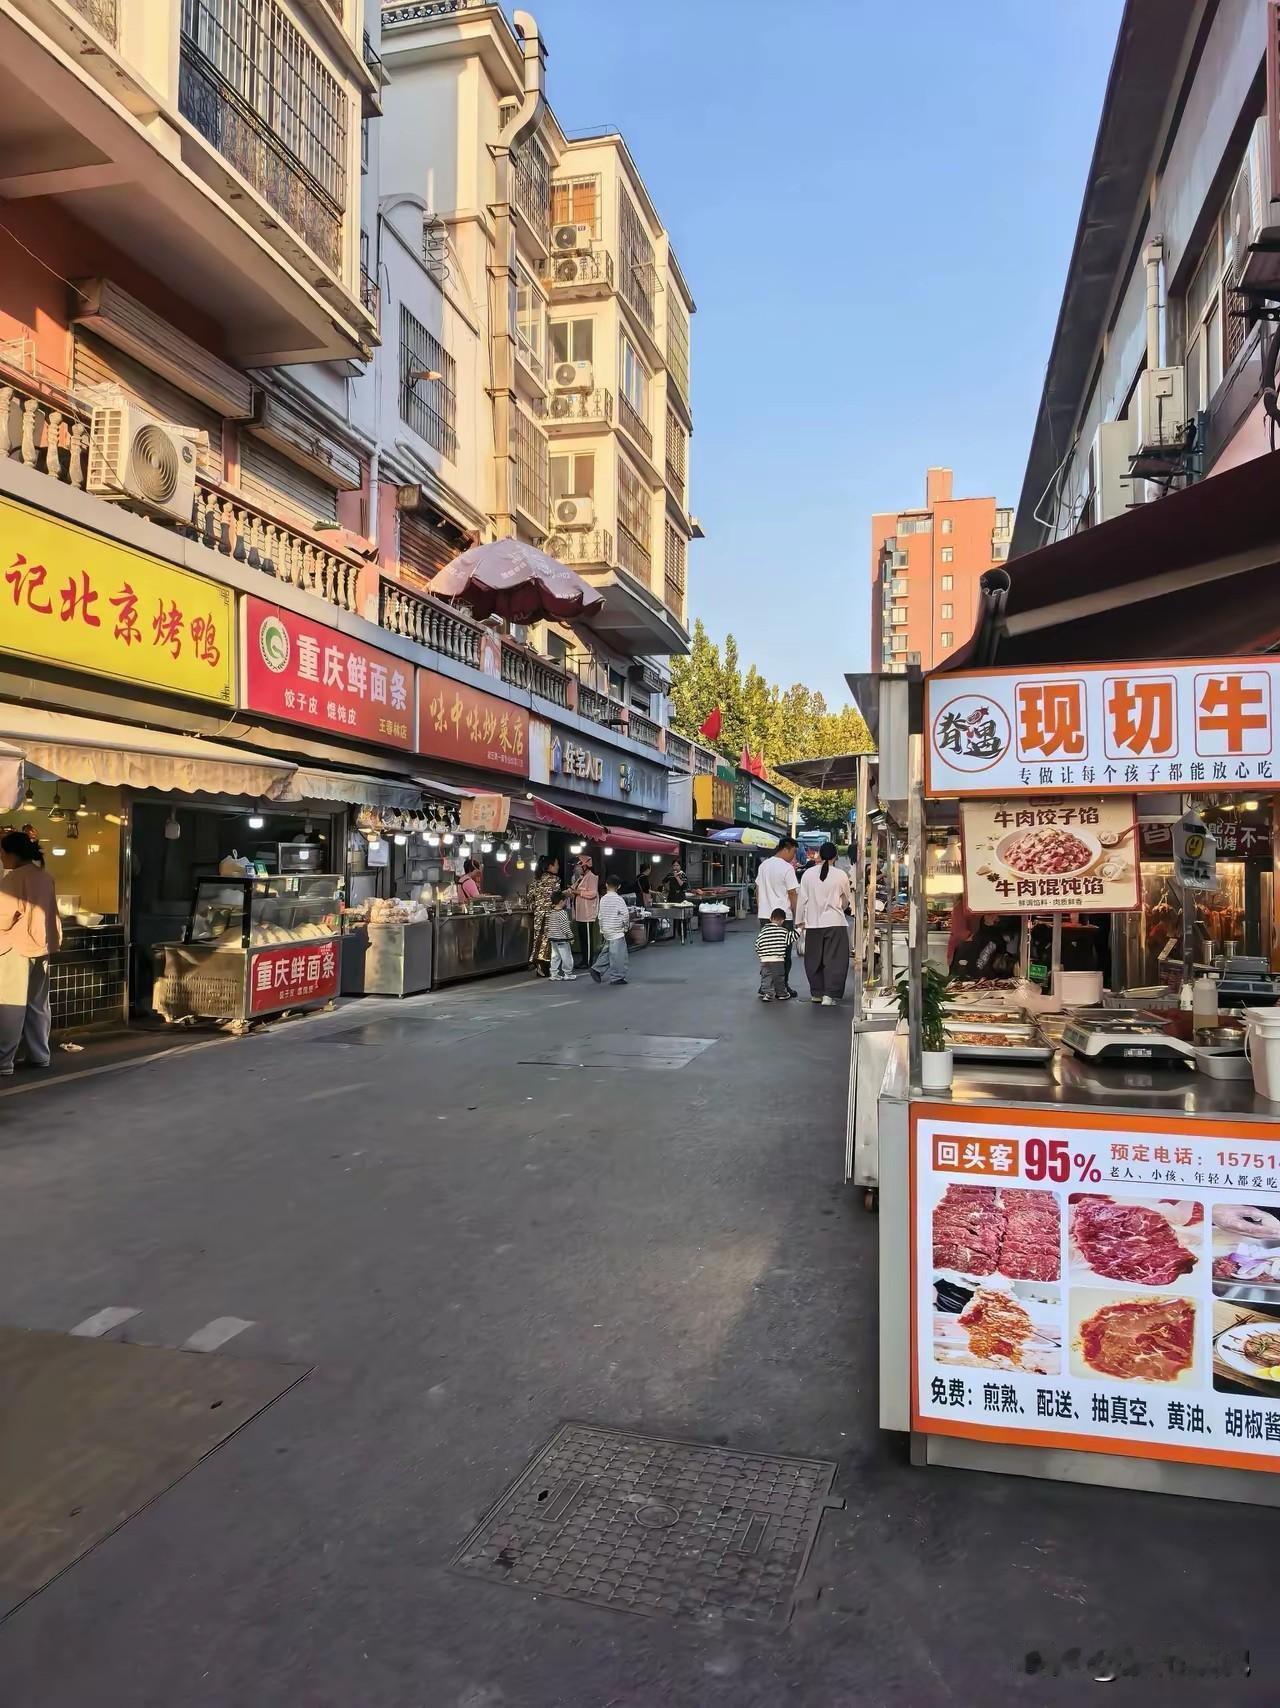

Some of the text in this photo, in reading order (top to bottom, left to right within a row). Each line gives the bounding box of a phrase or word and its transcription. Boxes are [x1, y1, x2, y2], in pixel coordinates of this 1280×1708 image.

[5, 553, 221, 667] 记北京烤鸭
[296, 634, 408, 711] 重庆鲜面条
[284, 688, 357, 726] 饺子皮 馄饨皮
[429, 690, 524, 755] 味中味炒菜店
[1019, 675, 1267, 757] 现切牛
[1018, 760, 1273, 785] 专做让每个孩子都能放心吃
[993, 806, 1099, 828] 牛肉饺子馅
[995, 877, 1104, 897] 牛肉馄饨馅
[256, 952, 335, 991] 重庆鲜面条
[937, 1138, 1102, 1183] 回头客 95%
[1109, 1166, 1278, 1189] 老人、小孩、年轻人都爱吃
[1216, 1151, 1280, 1169] 15751
